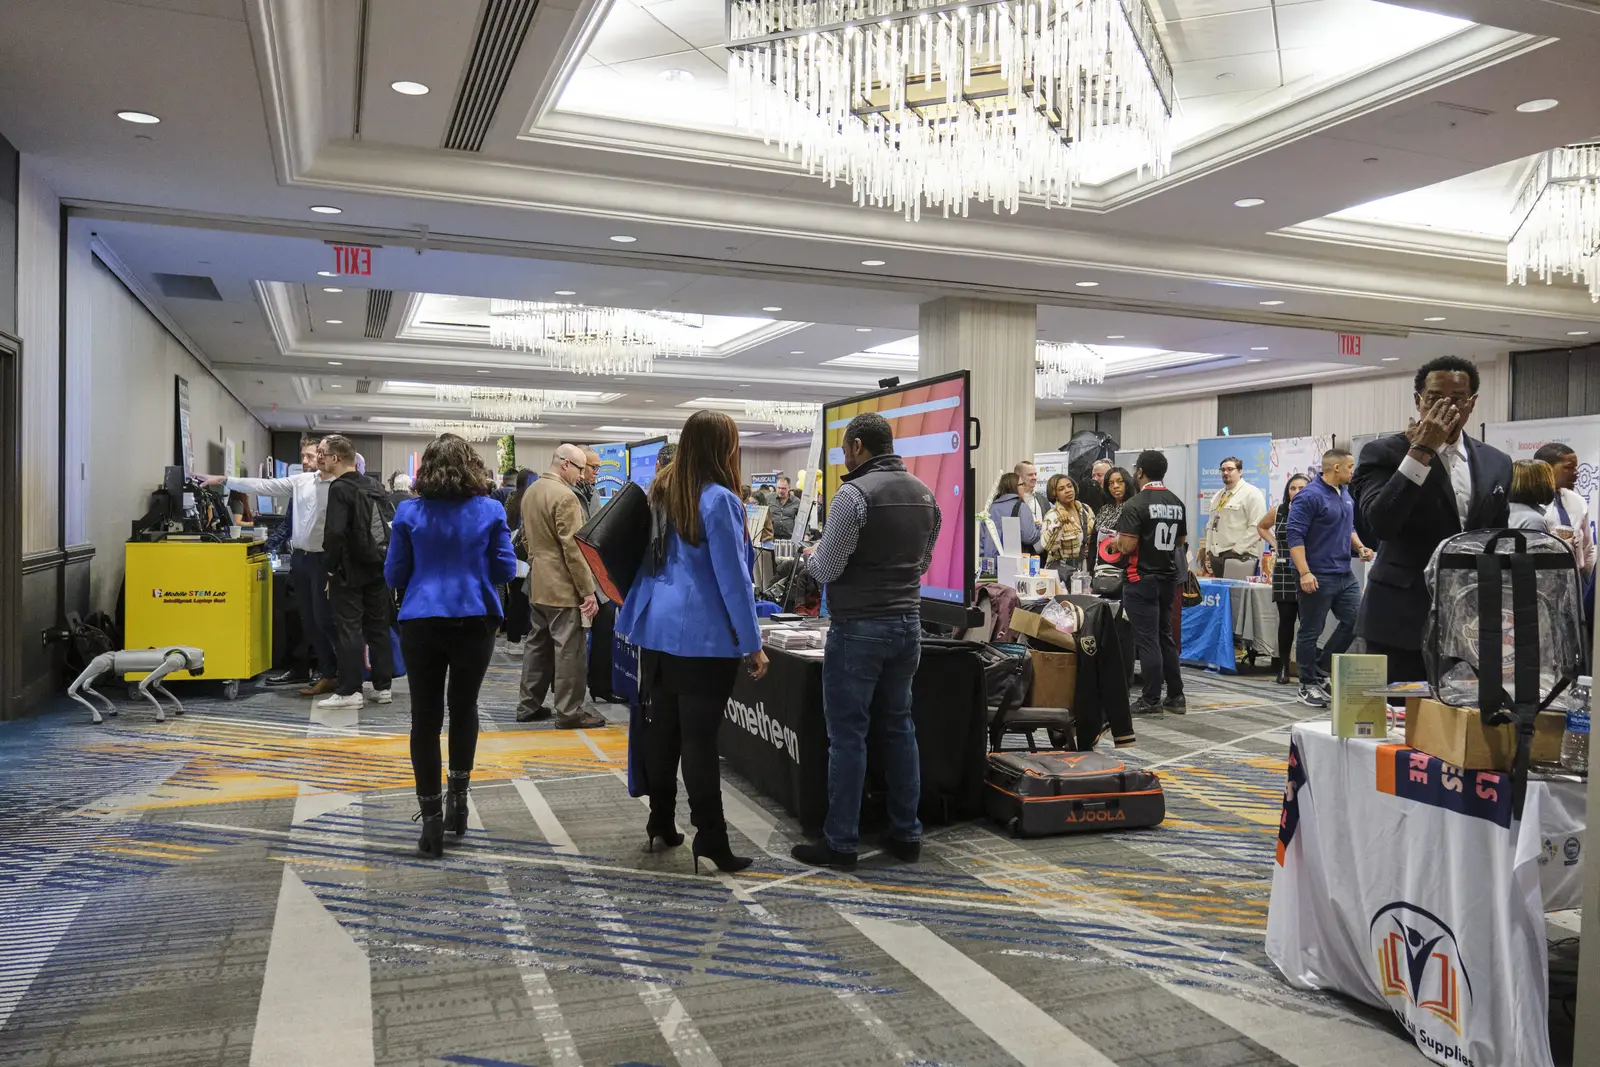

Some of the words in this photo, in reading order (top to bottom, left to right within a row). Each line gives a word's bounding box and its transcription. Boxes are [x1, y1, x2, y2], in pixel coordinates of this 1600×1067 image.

[1149, 503, 1183, 520] CADETS
[723, 696, 800, 765] omethean
[1419, 1029, 1475, 1067] Supplies
